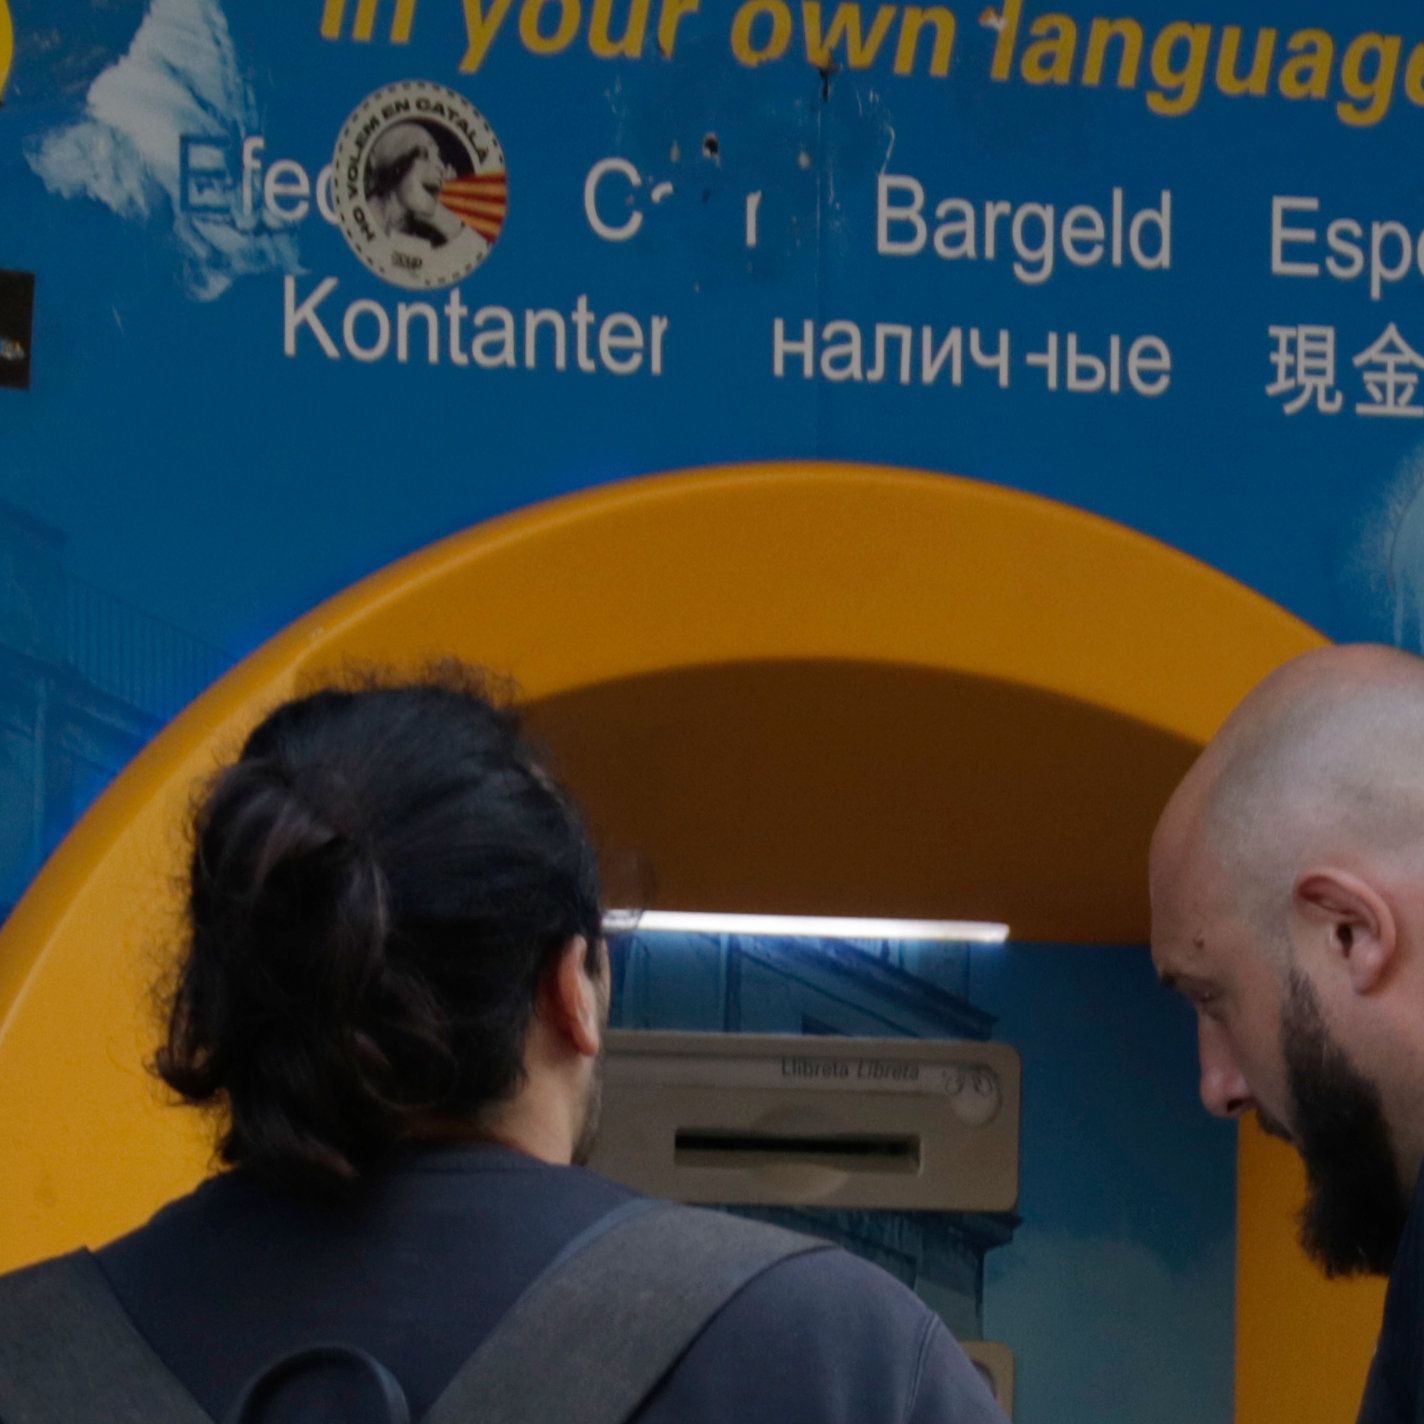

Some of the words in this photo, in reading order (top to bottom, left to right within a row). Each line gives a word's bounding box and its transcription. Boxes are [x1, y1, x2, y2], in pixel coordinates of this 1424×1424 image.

[459, 0, 700, 74] your
[730, 0, 956, 77] own
[381, 97, 411, 120] EN
[347, 116, 381, 199] VOLEM
[353, 206, 376, 243] HO
[876, 171, 1172, 284] Bargeld
[284, 274, 669, 375] Kontanter
[781, 1057, 850, 1078] Llibreta
